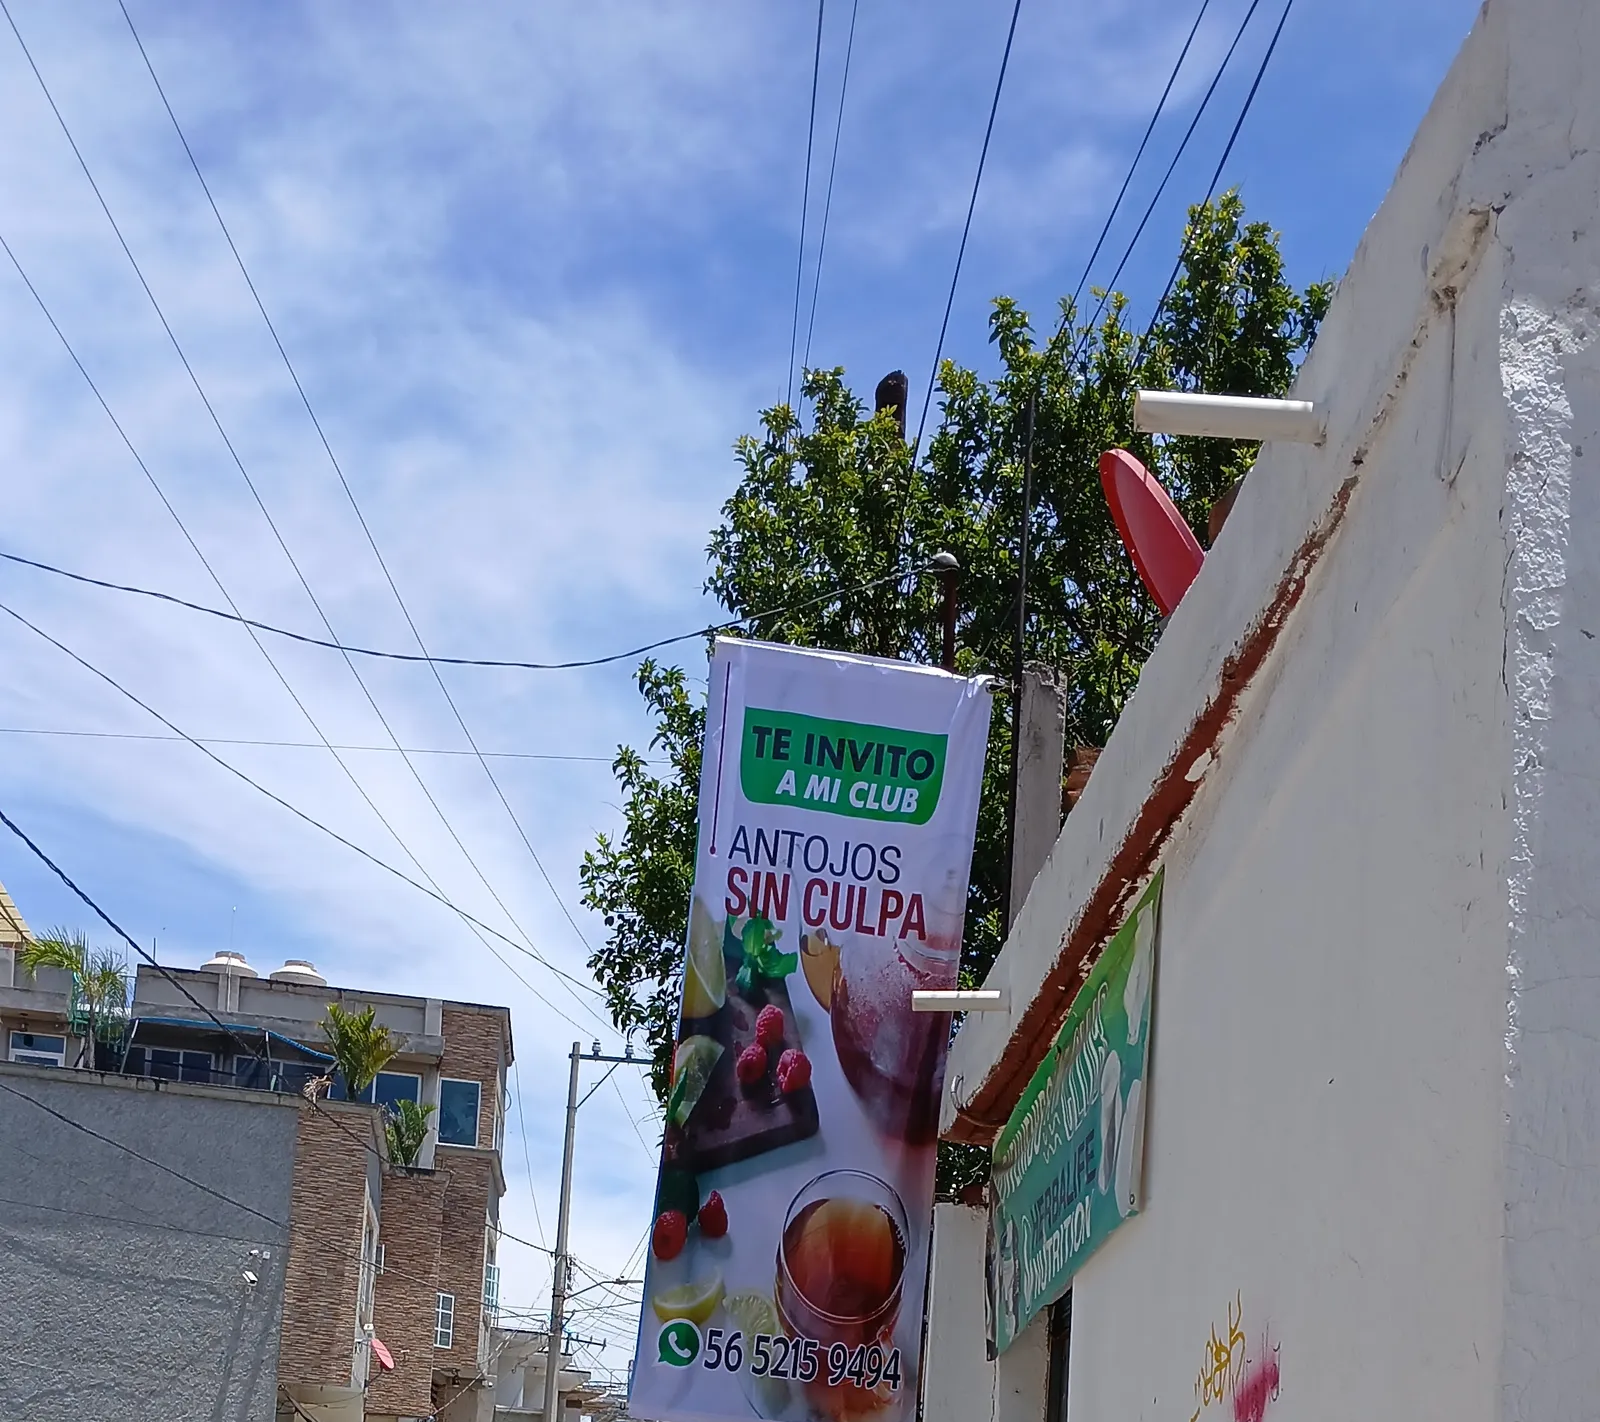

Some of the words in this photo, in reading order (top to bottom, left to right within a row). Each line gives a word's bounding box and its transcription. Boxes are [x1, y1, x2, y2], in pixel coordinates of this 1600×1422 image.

[752, 725, 792, 760] TE
[804, 733, 935, 781] INVITO
[775, 769, 797, 796] A
[804, 774, 840, 804] MI
[849, 781, 920, 813] CLUB
[727, 824, 902, 885] ANTOJOS
[725, 866, 791, 922] SIN
[802, 877, 927, 942] CULPA
[1030, 1129, 1097, 1251] HERBALIFE
[1032, 1188, 1094, 1299] NUTRITION
[702, 1328, 744, 1374] 56
[750, 1333, 820, 1382] 5215
[827, 1342, 902, 1391] 9494
